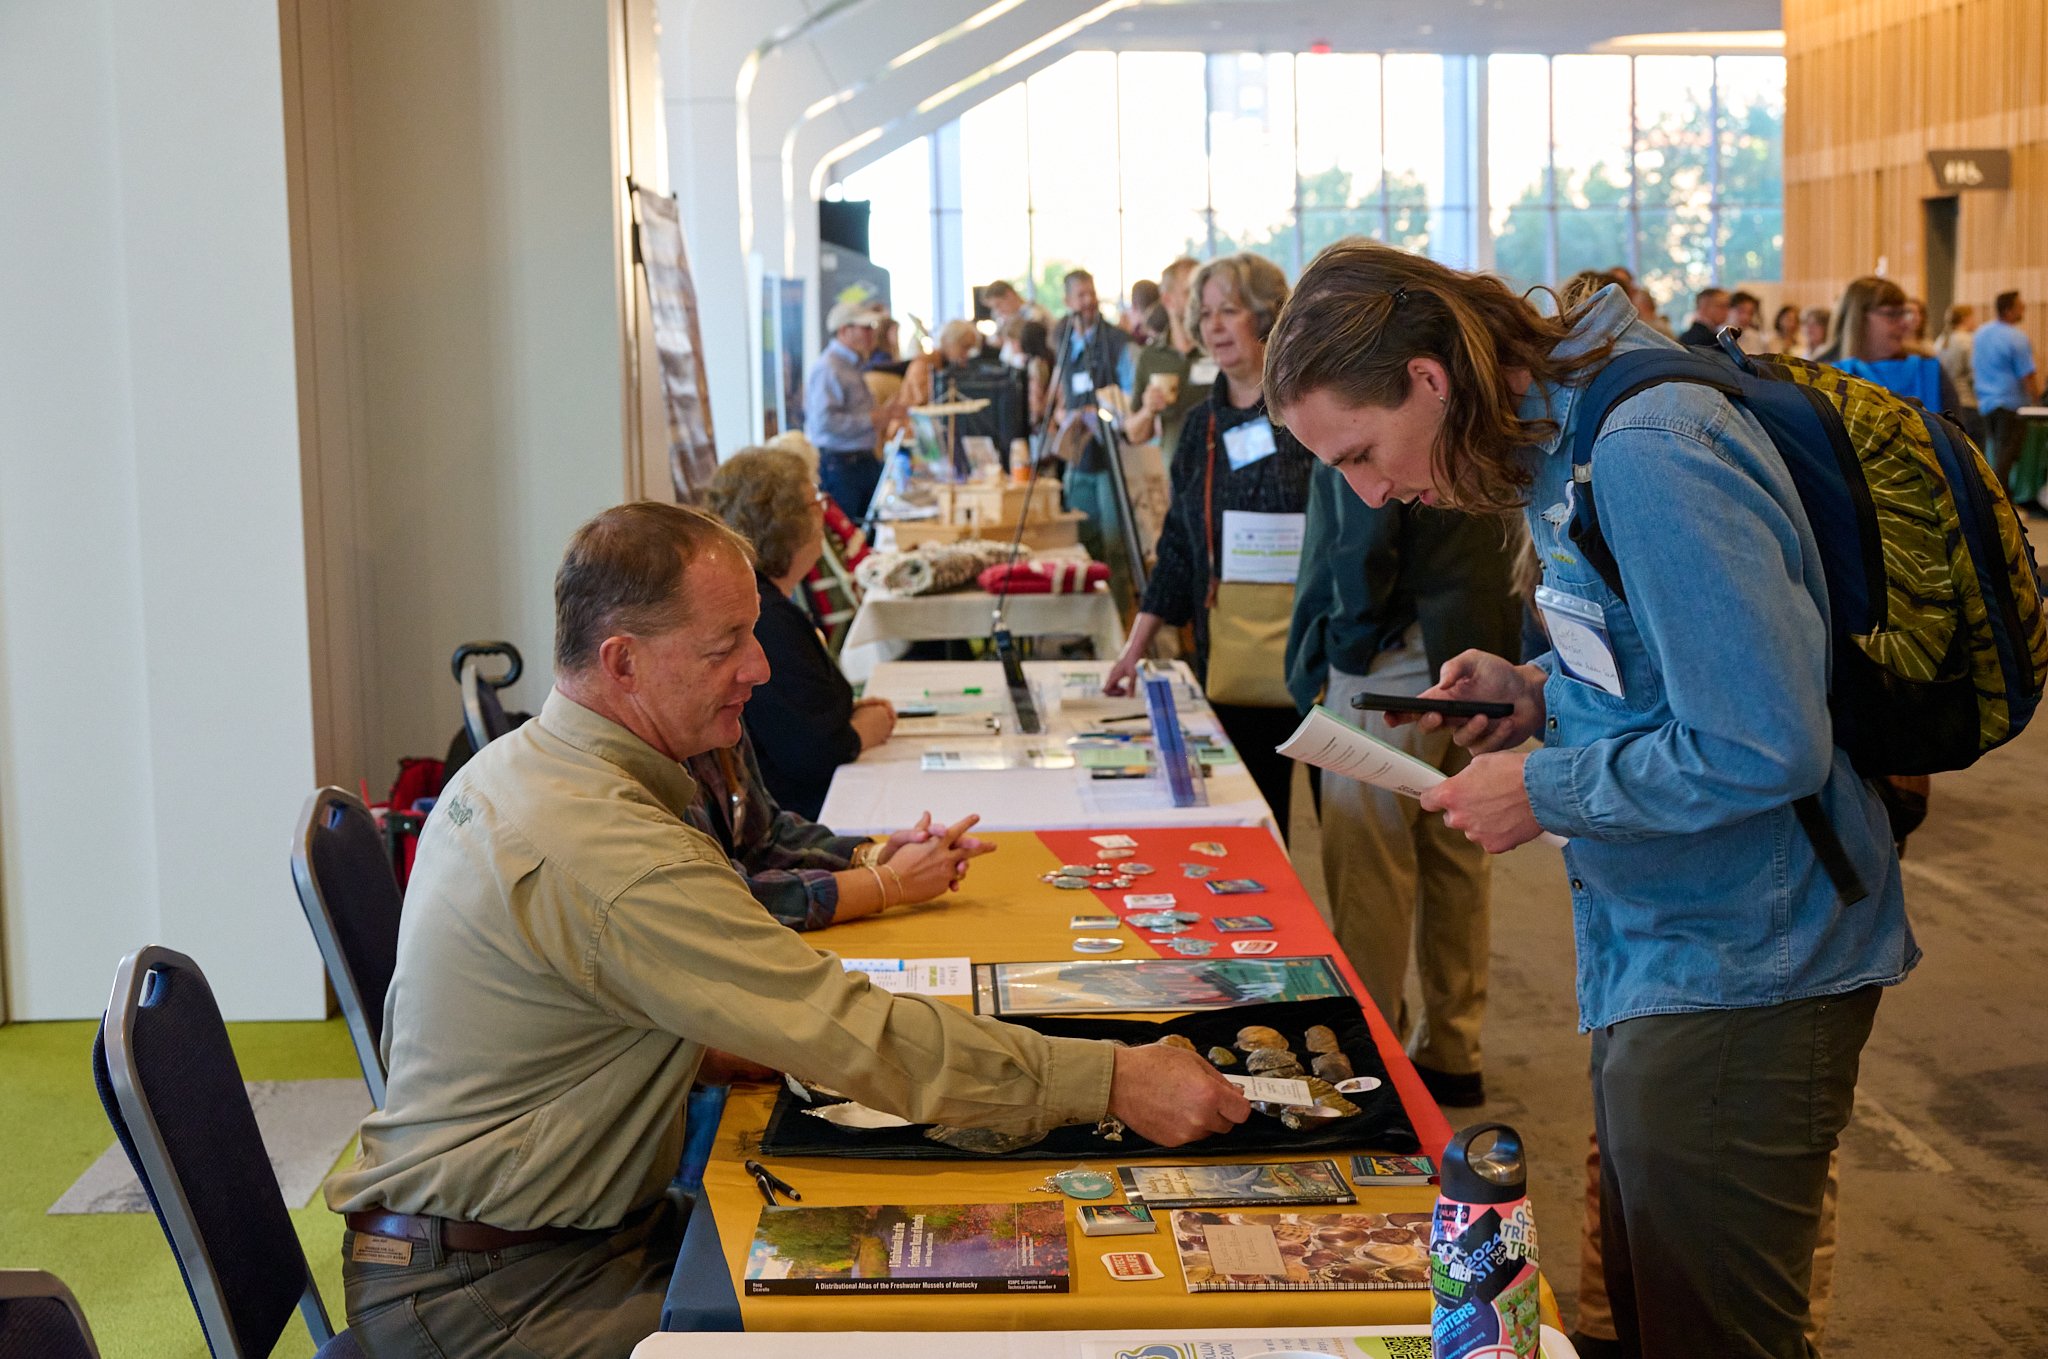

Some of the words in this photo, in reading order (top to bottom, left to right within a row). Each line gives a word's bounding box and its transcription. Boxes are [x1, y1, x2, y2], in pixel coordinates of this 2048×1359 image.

[1464, 1232, 1501, 1269] 2024
[1449, 1262, 1472, 1283] OVER
[815, 1282, 820, 1290] A
[820, 1282, 858, 1290] Distributional
[858, 1282, 872, 1290] Atlas
[952, 1281, 978, 1290] Kentucky
[1441, 1321, 1472, 1345] NETWORK
